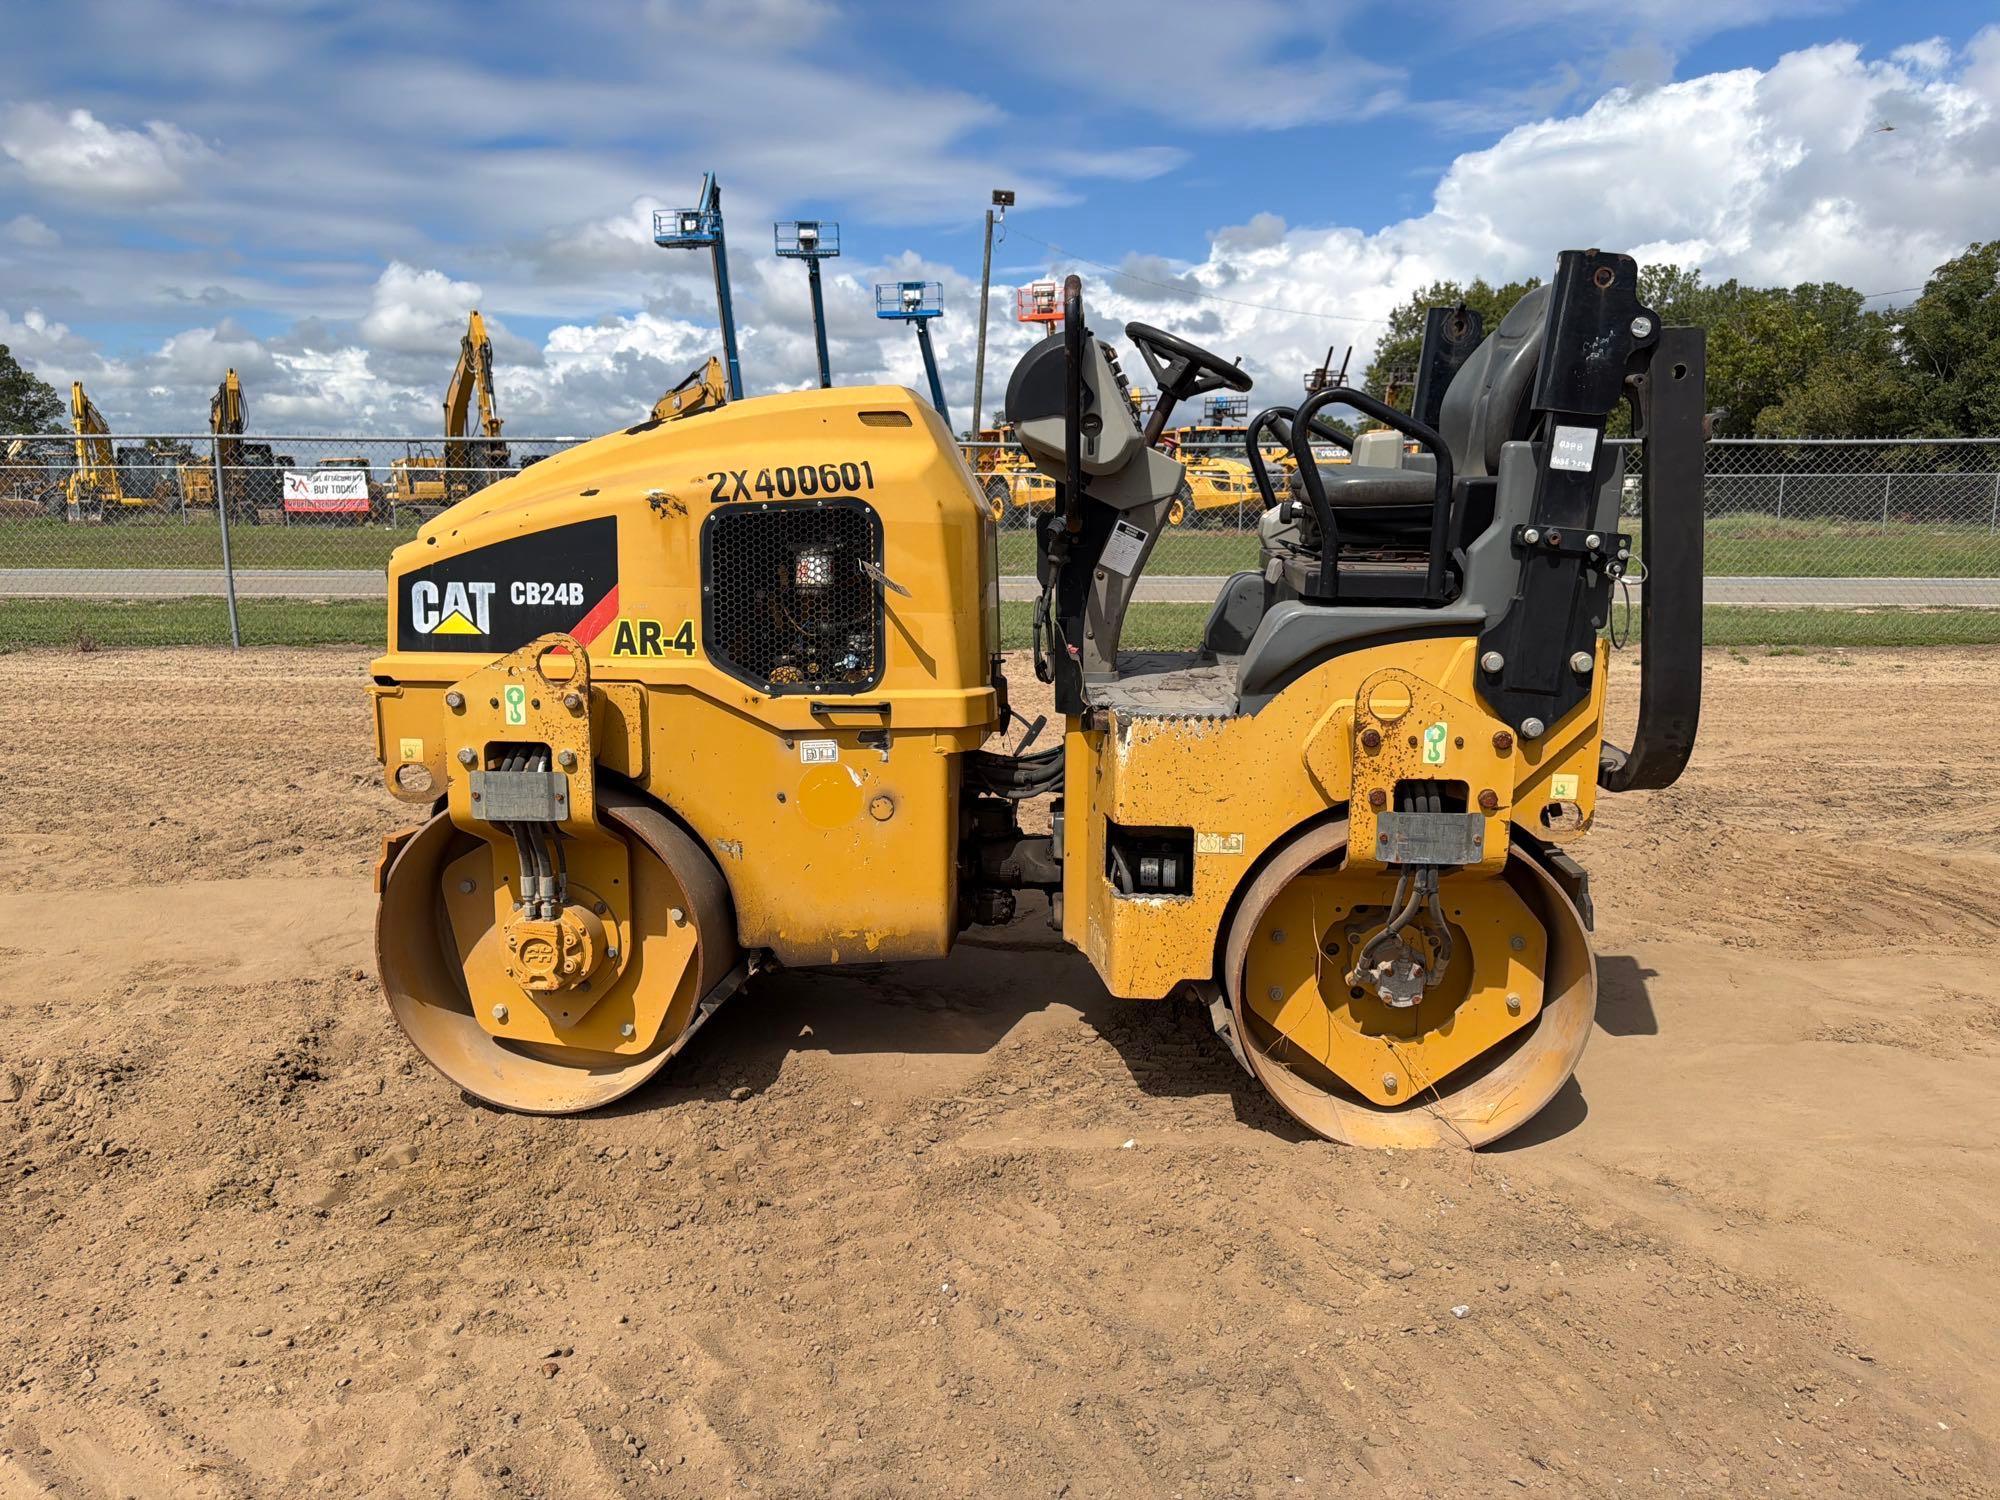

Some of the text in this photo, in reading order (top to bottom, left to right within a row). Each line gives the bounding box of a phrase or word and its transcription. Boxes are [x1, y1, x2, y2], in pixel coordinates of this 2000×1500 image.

[314, 484, 329, 495] BUY
[707, 460, 874, 504] 2X400601
[411, 580, 496, 635] CAT
[510, 581, 584, 606] CB24B
[612, 619, 697, 658] AR-4
